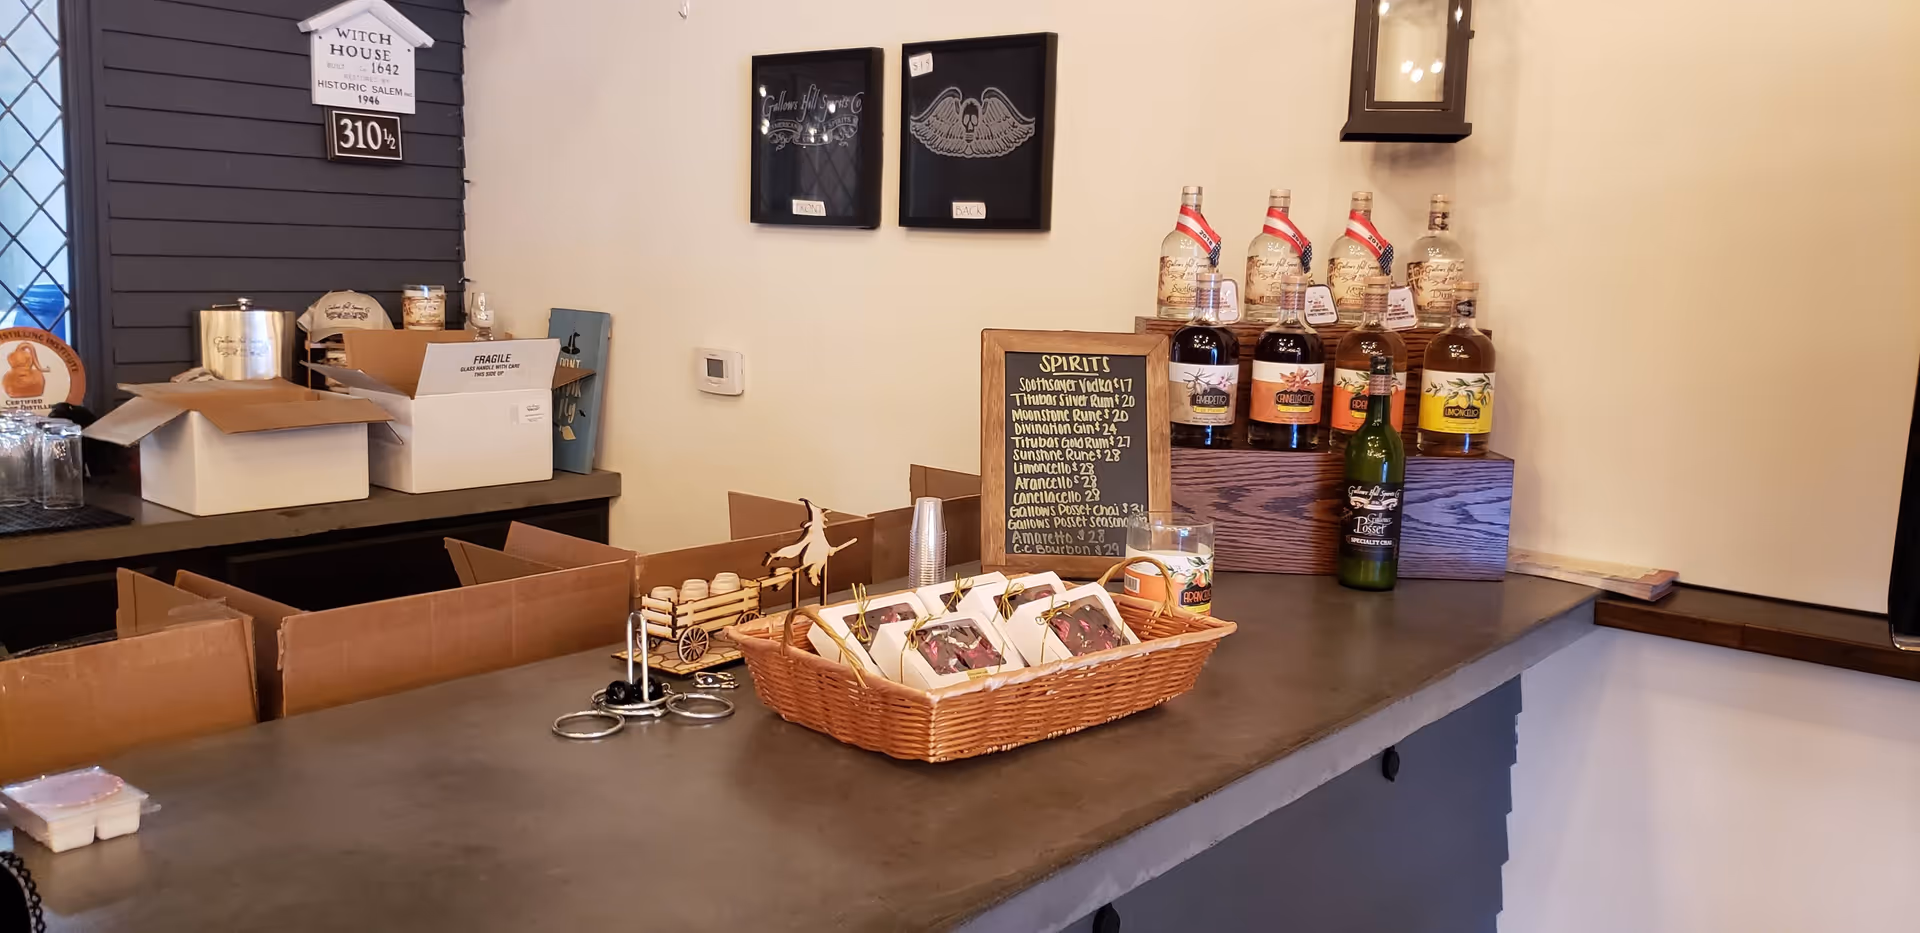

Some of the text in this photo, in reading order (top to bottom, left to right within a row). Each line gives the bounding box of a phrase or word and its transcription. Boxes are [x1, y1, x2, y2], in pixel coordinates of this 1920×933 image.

[335, 27, 392, 45] WITCH
[329, 44, 391, 61] HOUSE
[371, 62, 400, 76] 1642
[317, 79, 367, 93] HISTORIC
[371, 85, 403, 97] SALEM
[358, 94, 380, 106] 1946
[762, 91, 798, 121] Gallows
[955, 204, 983, 216] BACK
[1199, 230, 1213, 246] 2018
[474, 354, 512, 364] FRAGILE
[1040, 355, 1110, 373] SPIRITS
[1019, 377, 1132, 393] Soothsayer Vodka $17
[1010, 393, 1135, 408] Titubas Silver Rum $20
[1195, 394, 1227, 405] AMARETTO
[1011, 408, 1129, 422] Moonstone Rune $20
[1445, 407, 1480, 418] LIMONCELLO
[1014, 421, 1117, 435] Divination Gin $24
[1010, 436, 1131, 449] Titubas Gold Rum $27
[1012, 448, 1121, 462] Sunstone Rune $28
[1013, 462, 1095, 475] Limoncello $28
[1015, 474, 1098, 491] Arancello $28
[1084, 488, 1100, 502] 28
[1009, 504, 1056, 518] Gallows
[1058, 503, 1092, 516] Posset
[1007, 518, 1050, 530] Gallows
[1054, 516, 1088, 530] Posset
[1353, 515, 1388, 536] Posset
[1012, 530, 1073, 545] Amaretto
[1351, 537, 1379, 546] SPECIALTY
[1036, 544, 1091, 556] Bourbon
[1094, 542, 1120, 556] $29
